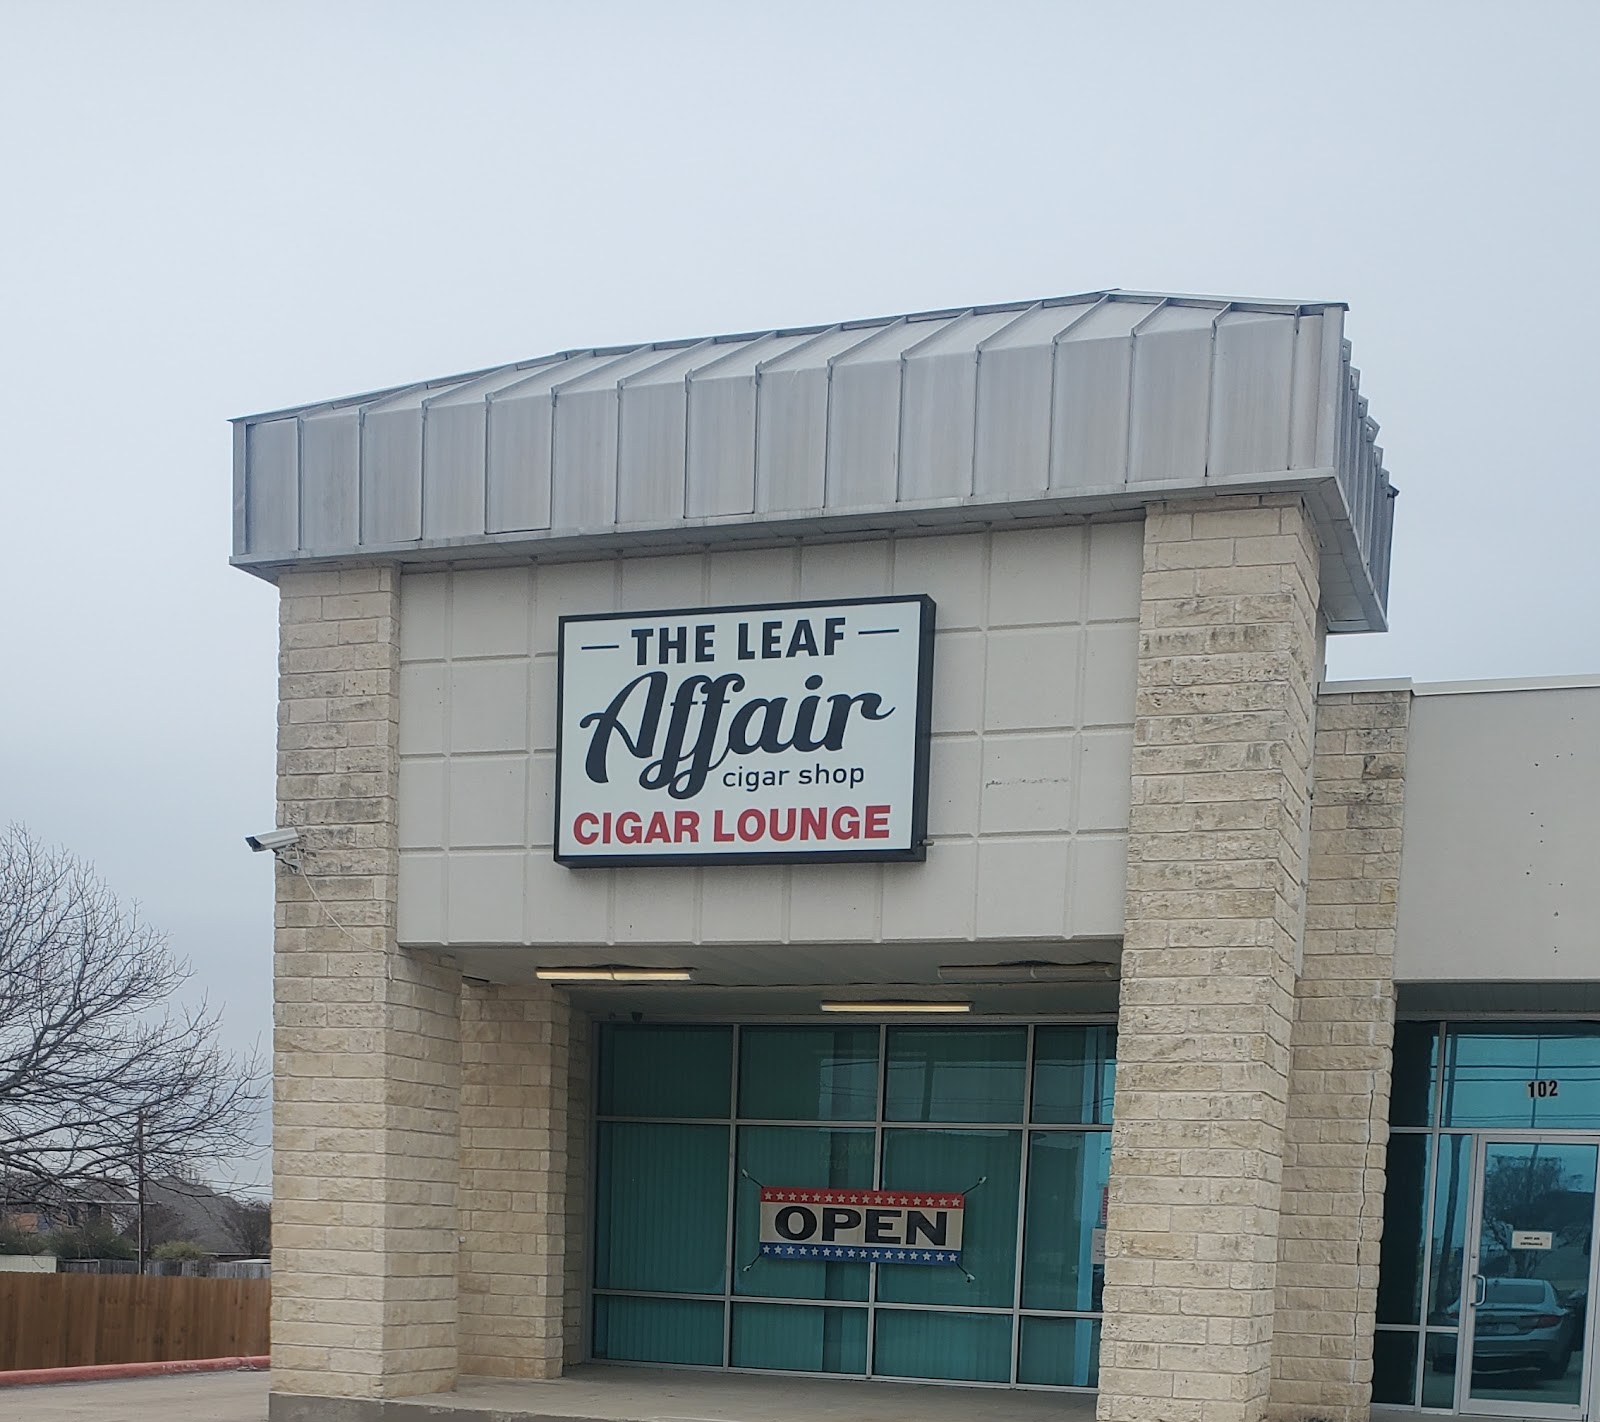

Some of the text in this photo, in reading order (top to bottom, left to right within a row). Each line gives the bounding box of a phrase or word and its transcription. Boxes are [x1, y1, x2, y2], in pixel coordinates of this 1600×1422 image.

[631, 617, 846, 665] THE LEAF
[579, 671, 896, 800] Affair
[722, 763, 865, 792] cigar shop
[573, 805, 891, 845] CIGAR LOUNGE
[1527, 1080, 1558, 1098] 102
[774, 1205, 948, 1246] OPEN
